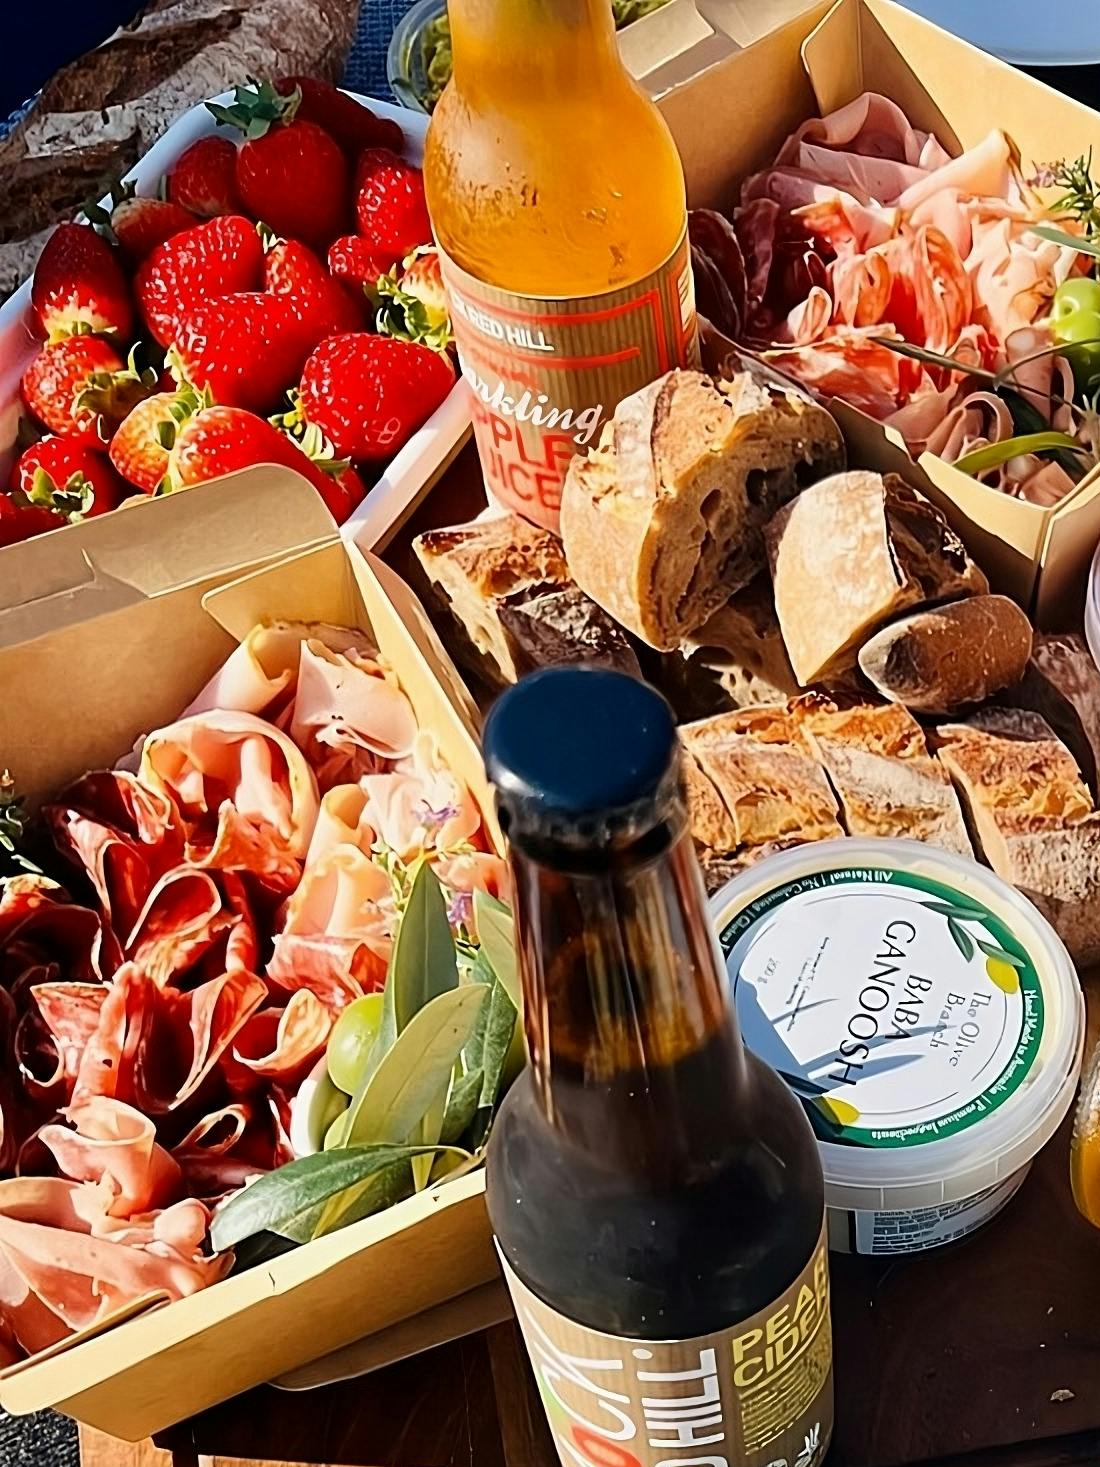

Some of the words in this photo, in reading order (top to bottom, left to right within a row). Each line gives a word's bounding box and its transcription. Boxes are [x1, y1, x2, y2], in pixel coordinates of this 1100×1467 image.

[468, 305, 504, 340] RED
[506, 325, 554, 351] HILL
[828, 920, 916, 1086] GANOOSH
[884, 974, 933, 1039] BABA
[967, 992, 992, 1018] The
[949, 1021, 980, 1067] Olive
[636, 1347, 725, 1448] HILL
